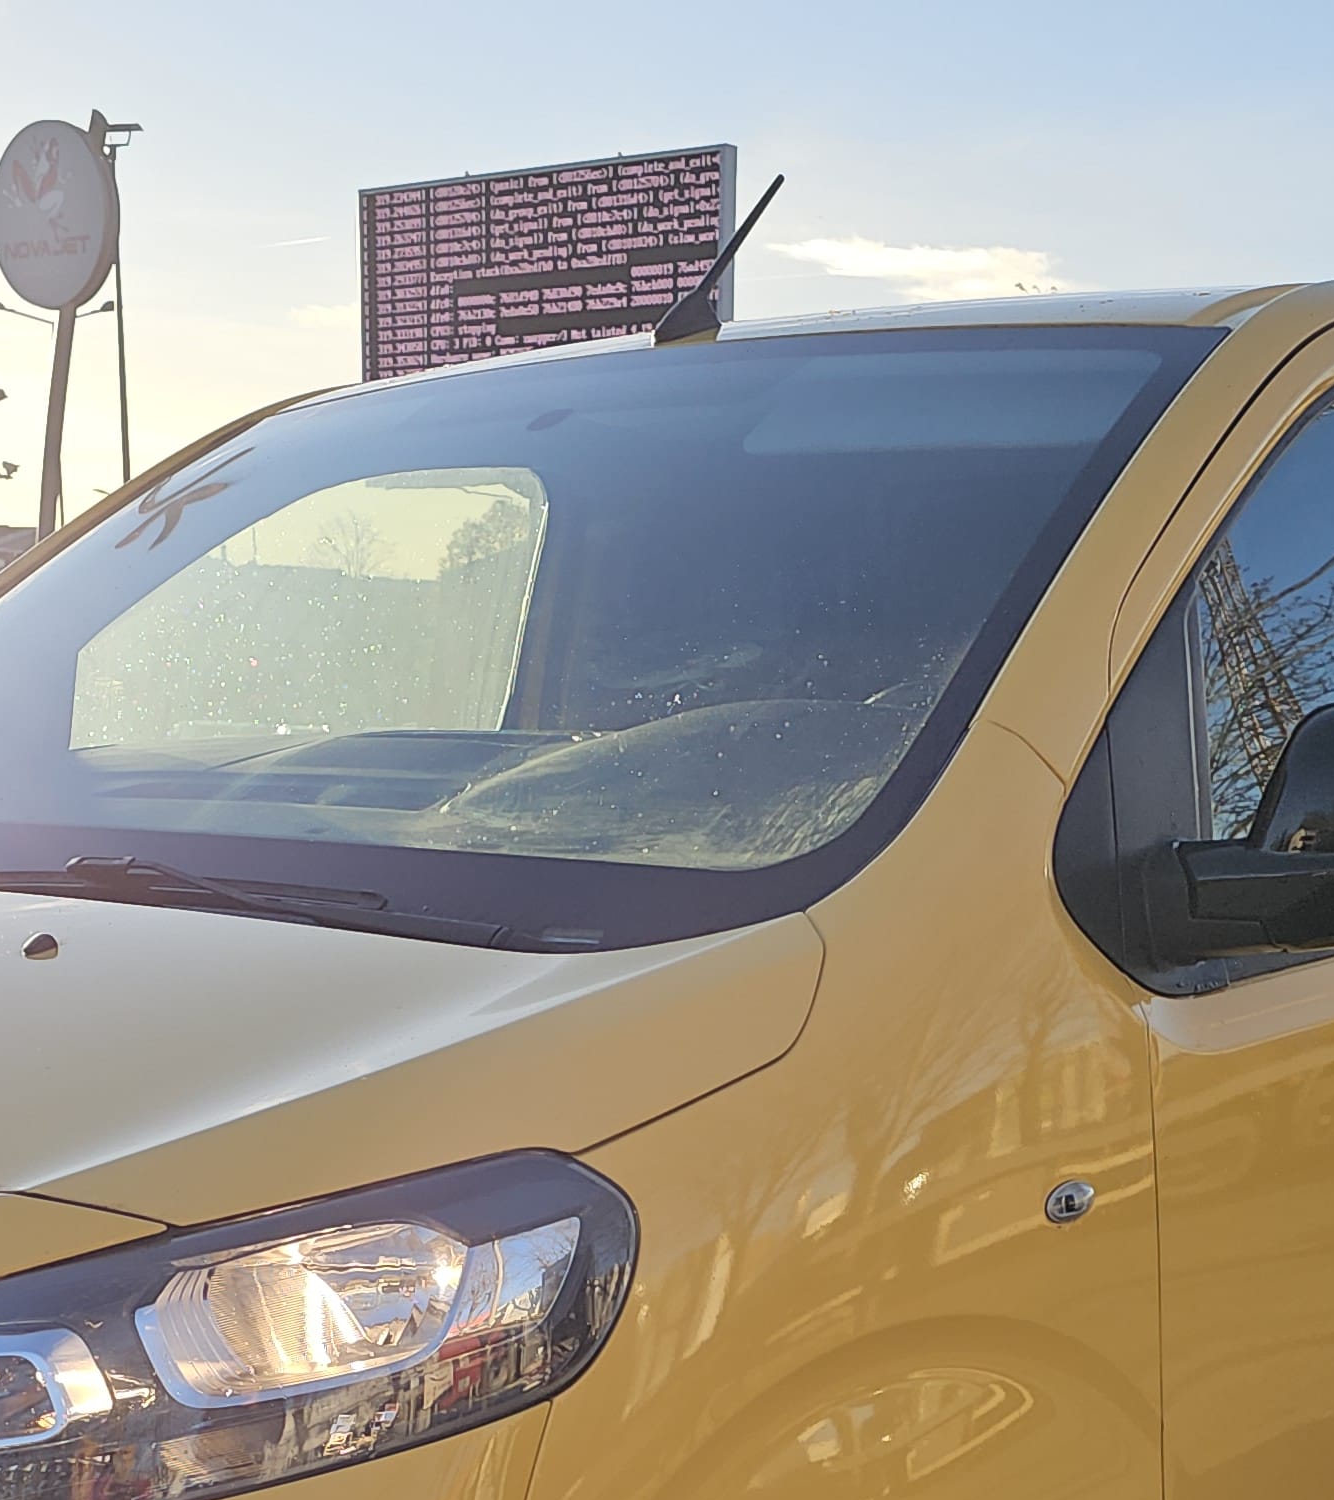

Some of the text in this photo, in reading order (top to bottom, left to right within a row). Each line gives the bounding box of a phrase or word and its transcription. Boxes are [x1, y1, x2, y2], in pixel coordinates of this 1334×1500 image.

[528, 175, 548, 187] from
[587, 182, 607, 195] from
[567, 199, 587, 212] from
[553, 215, 572, 228] from
[548, 230, 567, 243] from
[577, 242, 597, 254] from
[431, 269, 472, 284] Exception
[459, 322, 496, 337] stopping
[432, 340, 450, 351] CPU:
[463, 337, 482, 348] PID:
[496, 334, 519, 346] Comm:
[572, 329, 587, 340] Not
[592, 325, 626, 338] tainted
